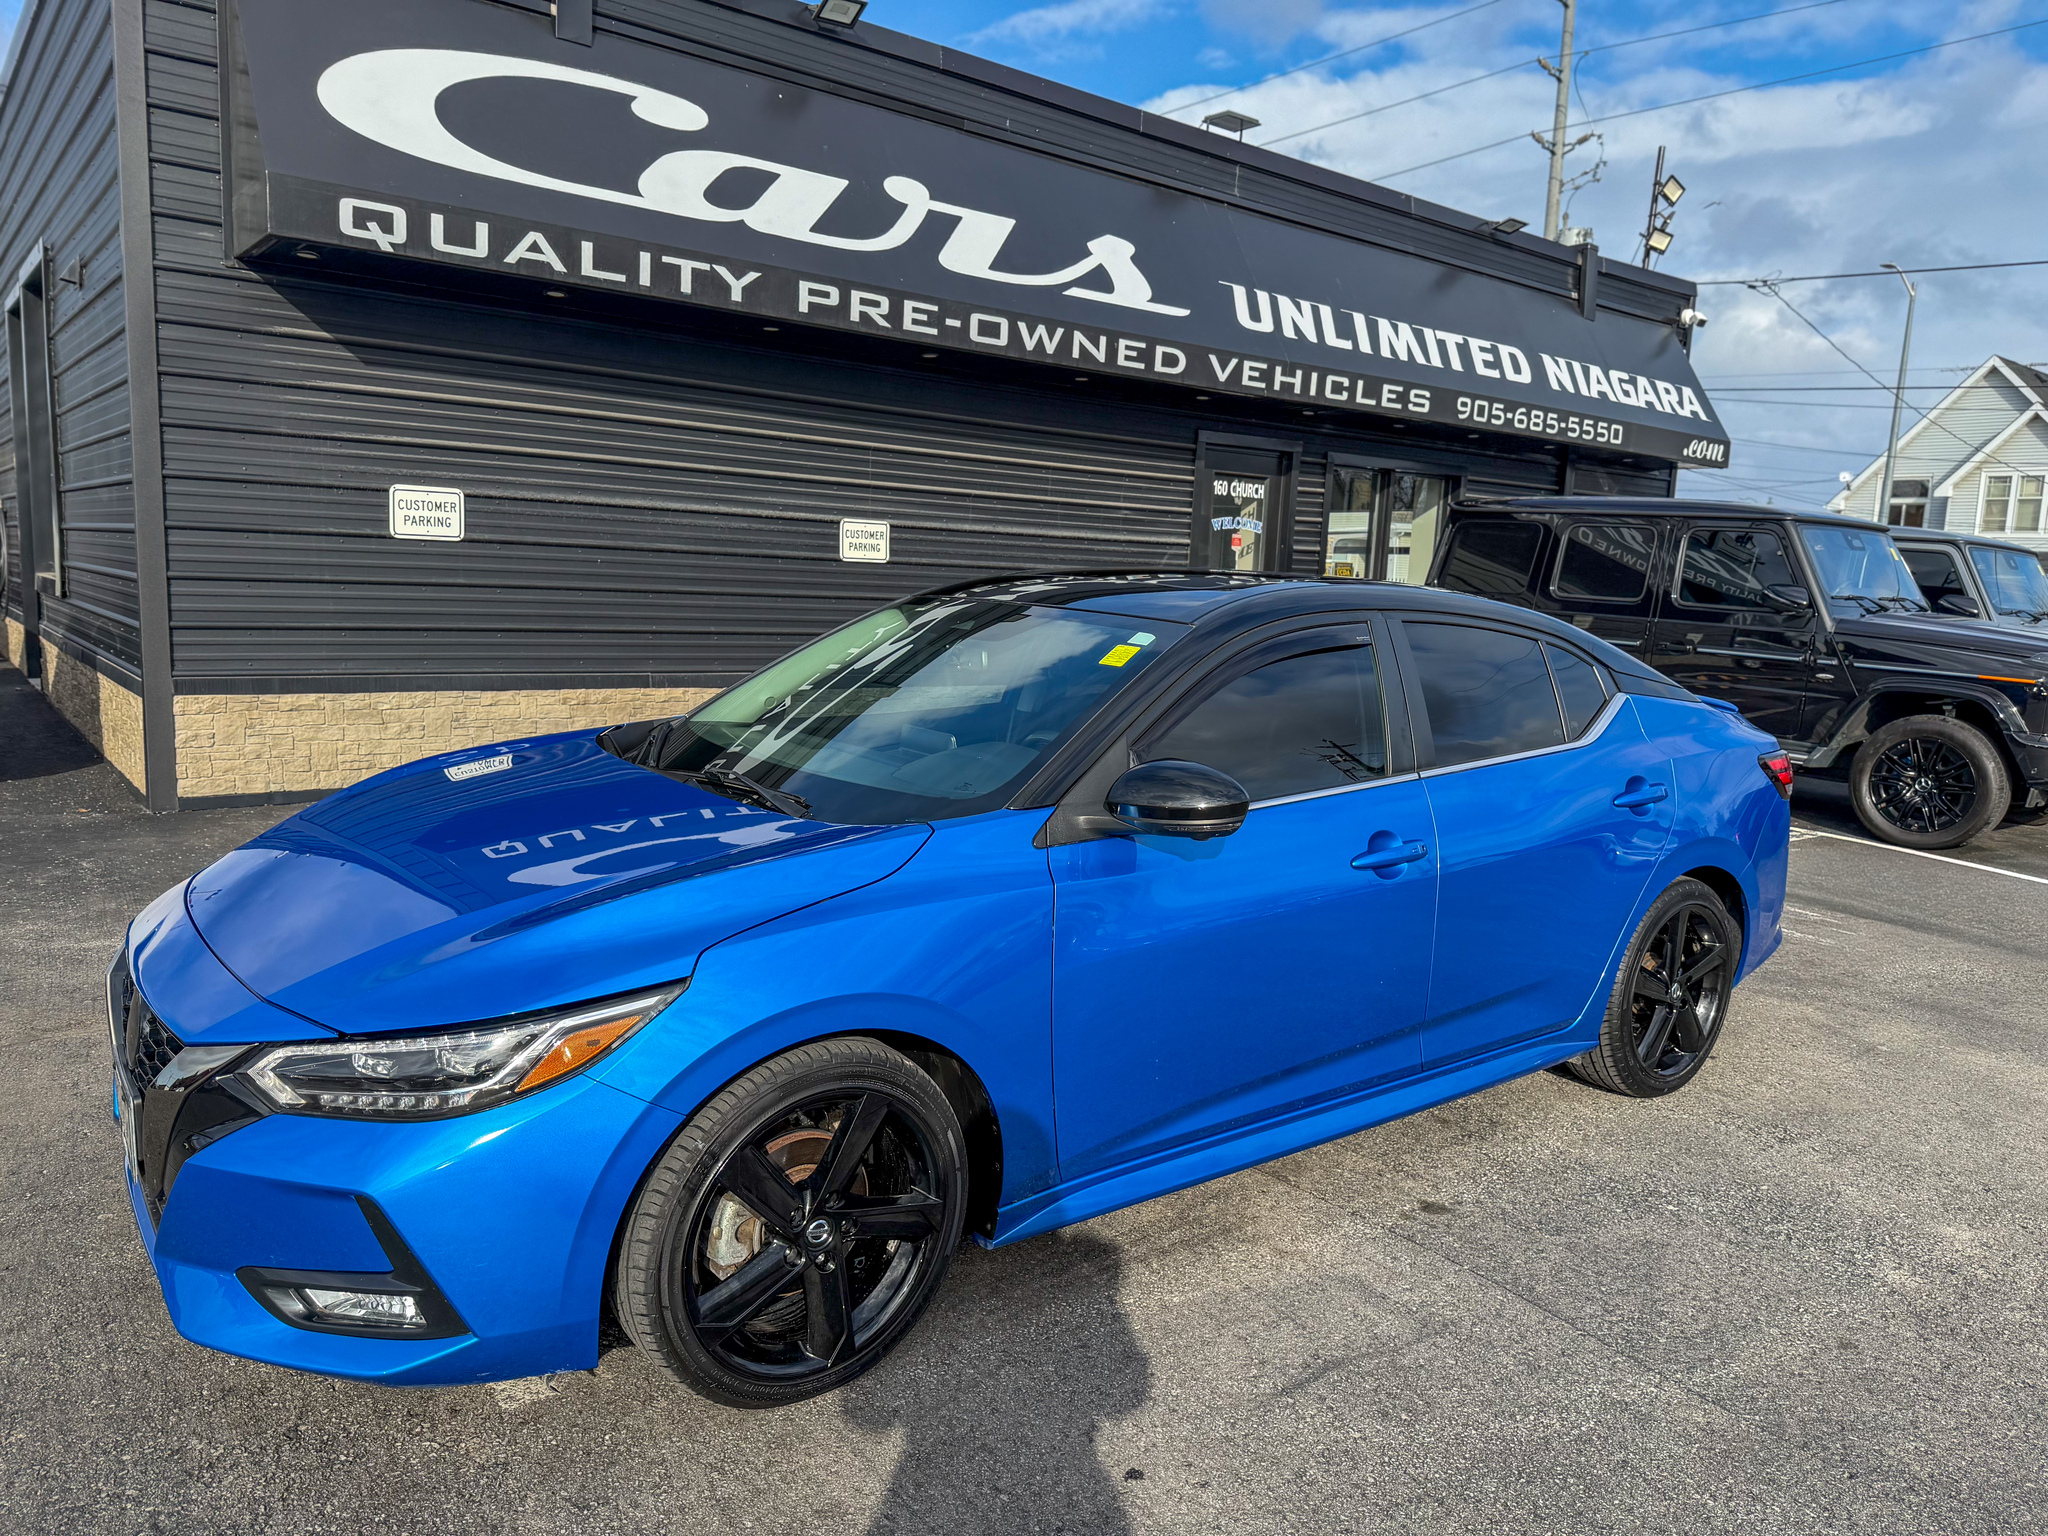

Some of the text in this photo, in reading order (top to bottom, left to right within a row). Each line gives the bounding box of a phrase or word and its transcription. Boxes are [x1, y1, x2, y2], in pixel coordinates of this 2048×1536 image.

[317, 48, 1190, 317] Cars
[338, 197, 1624, 445] QUALITY PRE-OWNED VEHICLES 905-685-5550
[1218, 280, 1714, 423] UNLIMITED NIAGARA
[1682, 438, 1727, 463] .com
[1213, 480, 1265, 499] 160 CHURCH
[397, 499, 457, 513] CUSTOMER
[403, 514, 452, 528] PARKING
[1211, 516, 1263, 534] WELCOME
[845, 529, 885, 541] CUSTOMER
[849, 541, 881, 553] PARKING
